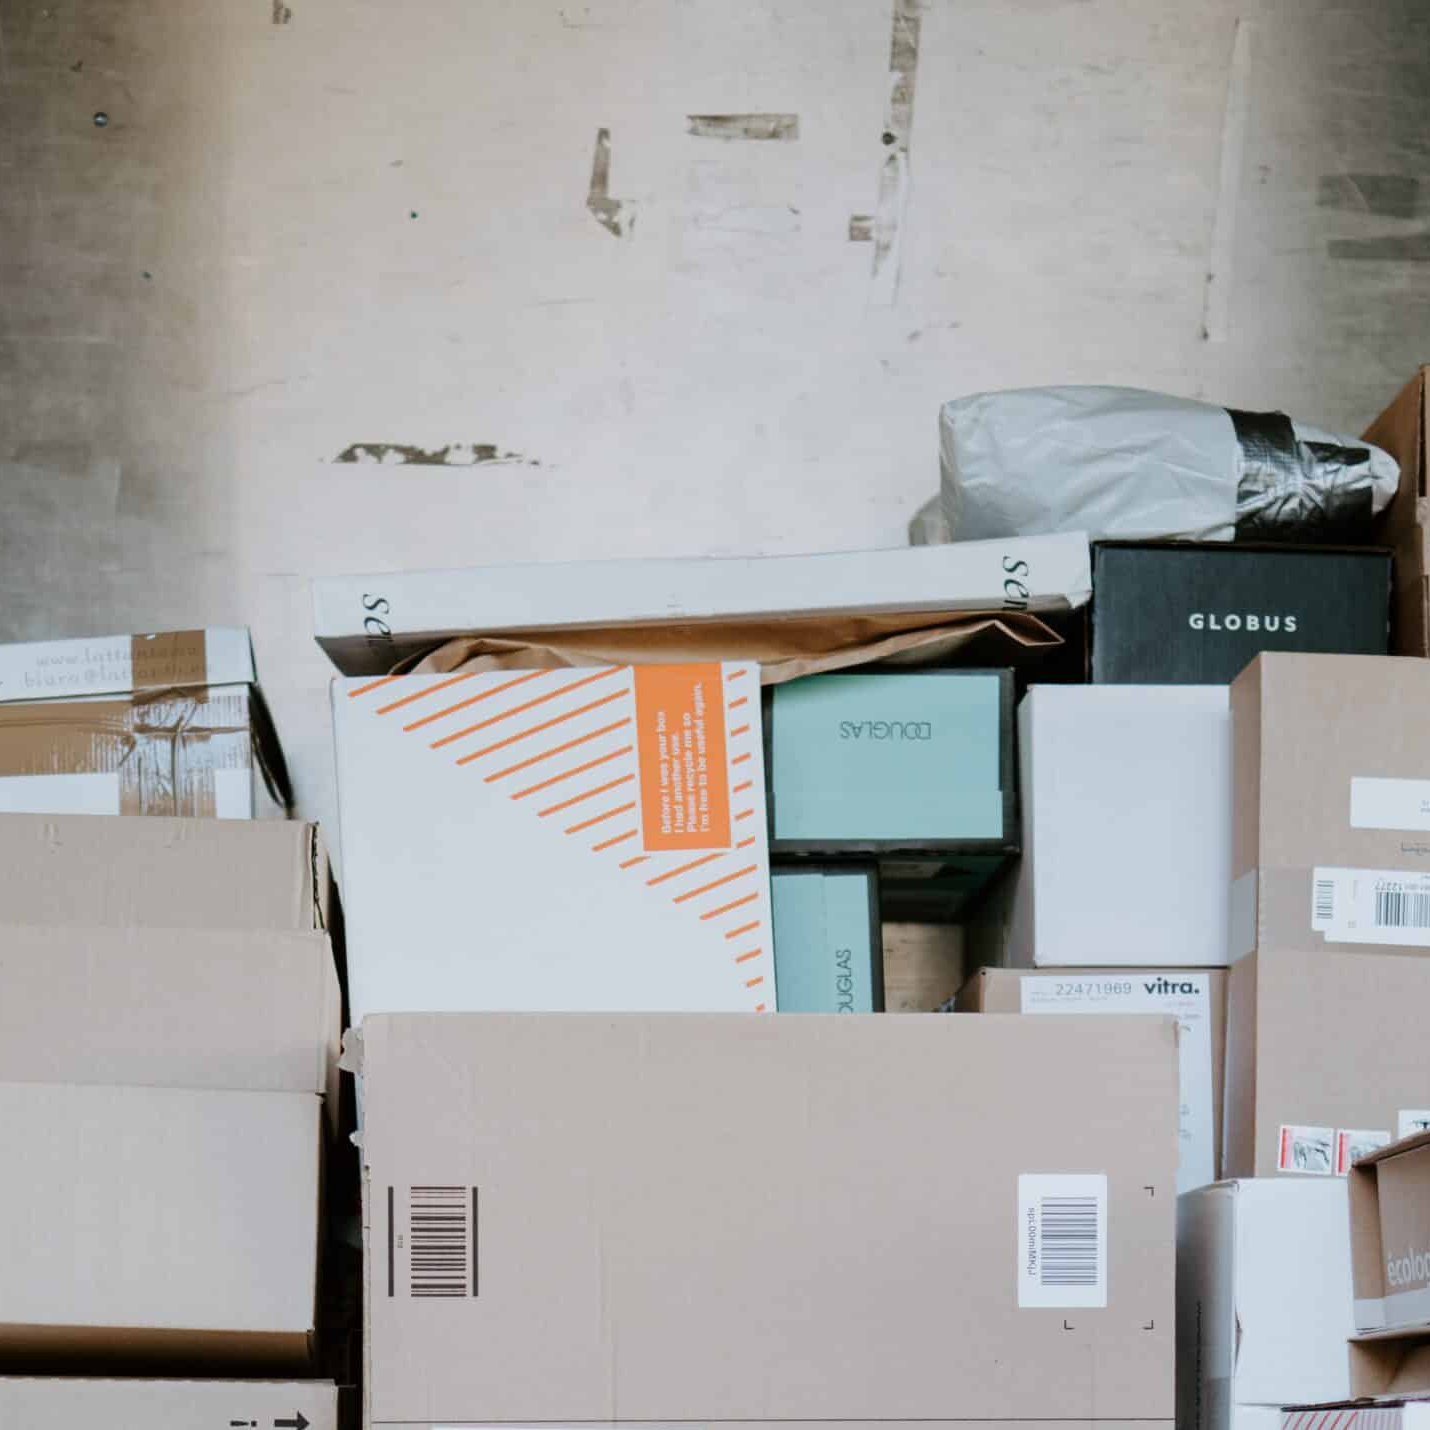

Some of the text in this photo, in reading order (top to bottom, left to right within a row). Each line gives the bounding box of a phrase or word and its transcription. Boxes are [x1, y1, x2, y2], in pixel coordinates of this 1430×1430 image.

[1188, 613, 1299, 633] GLOBUS
[838, 721, 933, 741] DOUGLAS
[657, 735, 669, 760] your
[659, 764, 669, 785] was
[660, 796, 672, 833] Before
[1143, 976, 1201, 995] vitra.
